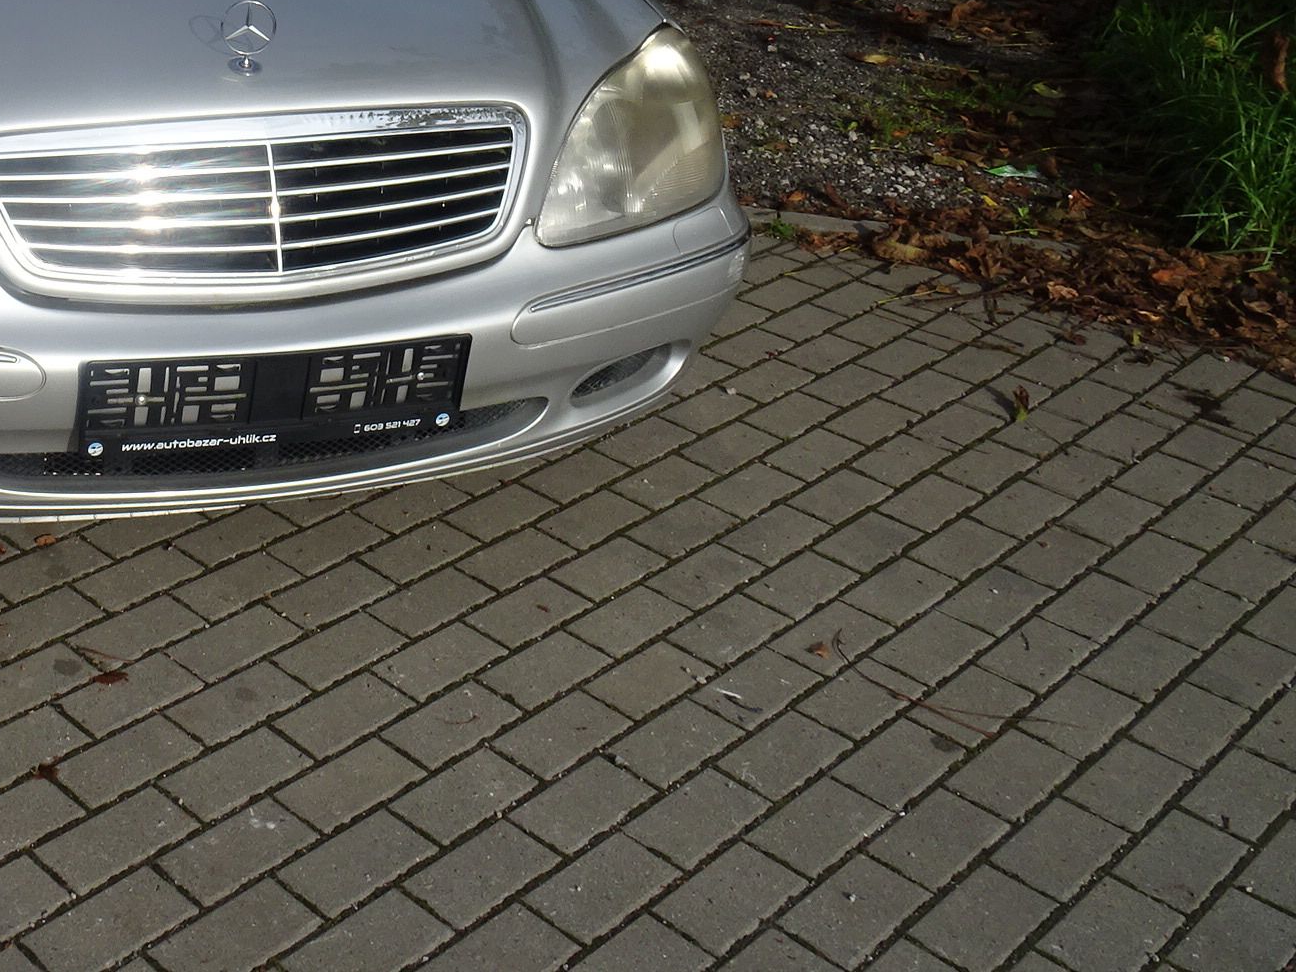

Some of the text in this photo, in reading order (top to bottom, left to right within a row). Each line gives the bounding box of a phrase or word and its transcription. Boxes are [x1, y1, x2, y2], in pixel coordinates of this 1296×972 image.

[364, 418, 421, 432] 603 521 427
[121, 433, 277, 452] www.autobazar-uhlik.cz
